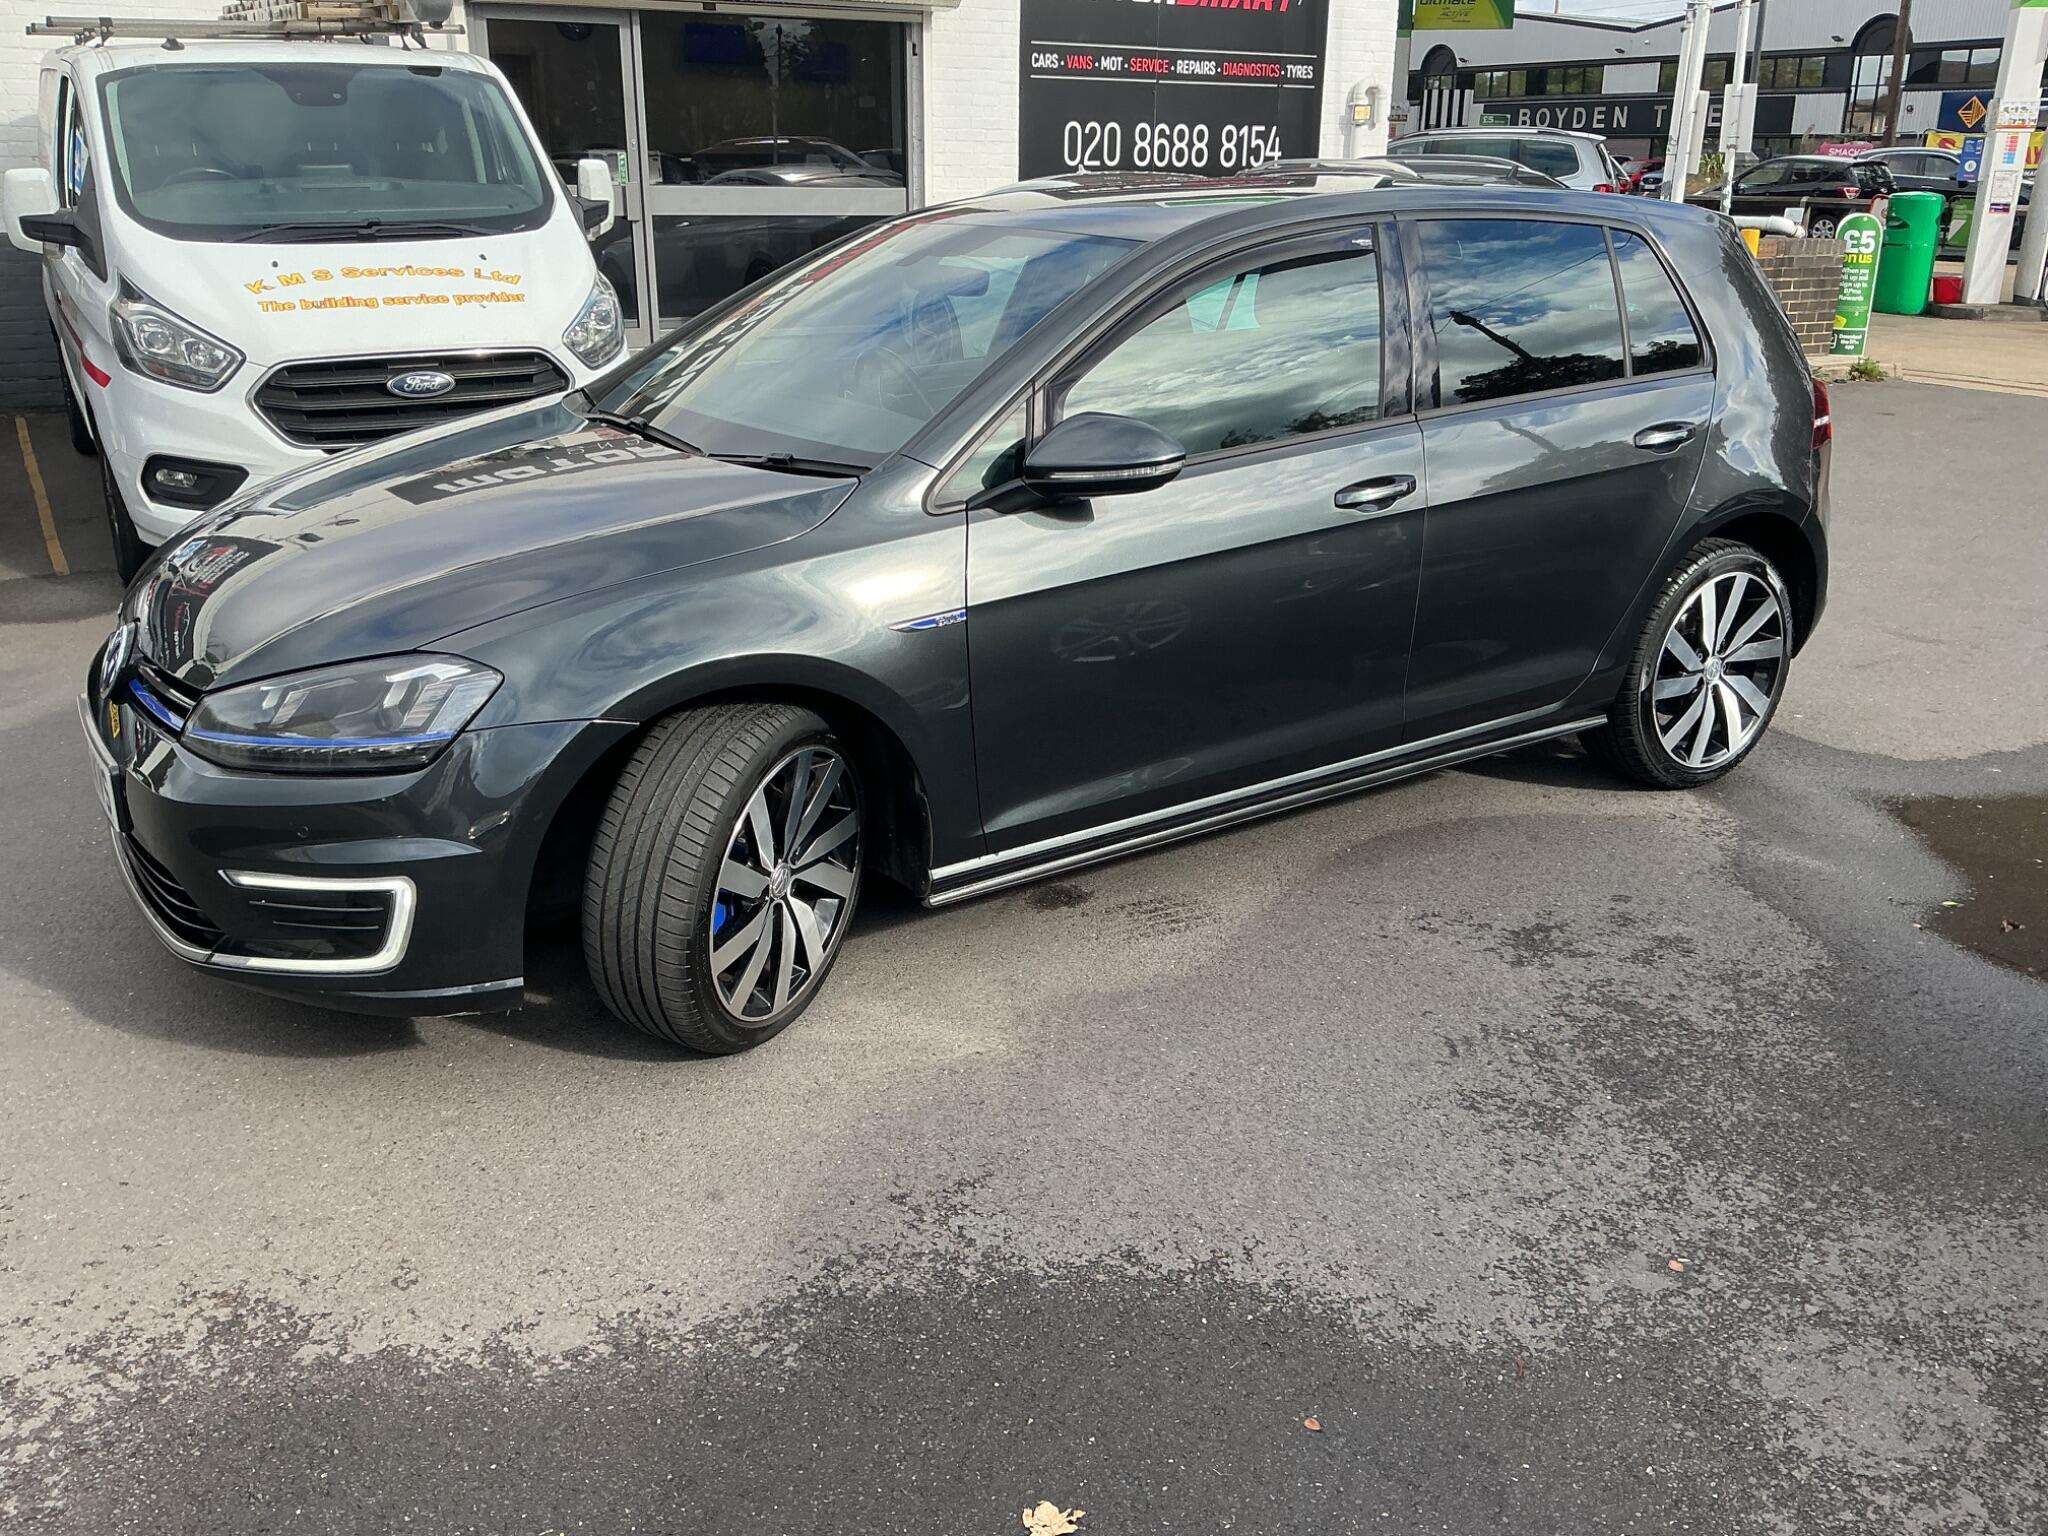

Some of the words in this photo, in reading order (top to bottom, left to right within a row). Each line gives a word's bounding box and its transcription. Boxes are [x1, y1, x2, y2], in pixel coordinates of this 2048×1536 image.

[1031, 53, 1058, 69] CARS
[1066, 56, 1093, 71] VANS
[1100, 57, 1123, 72] MOT
[1130, 58, 1169, 73] SERVICE
[1176, 60, 1216, 75] REPAIRS
[1223, 62, 1280, 78] DIAGNOSTICS
[1286, 65, 1314, 79] TYRES
[1518, 105, 1629, 128] BOYDEN
[1063, 121, 1121, 167] 020
[1133, 122, 1209, 168] 8688
[1220, 125, 1282, 168] 8154
[1843, 229, 1876, 254] £5
[276, 271, 307, 287] M
[311, 268, 334, 282] S
[341, 265, 465, 279] Services
[473, 267, 522, 286] Ltd
[257, 300, 297, 313] The
[299, 295, 379, 311] building
[382, 292, 450, 307] service
[452, 291, 526, 307] provider
[403, 375, 444, 393] Ford
